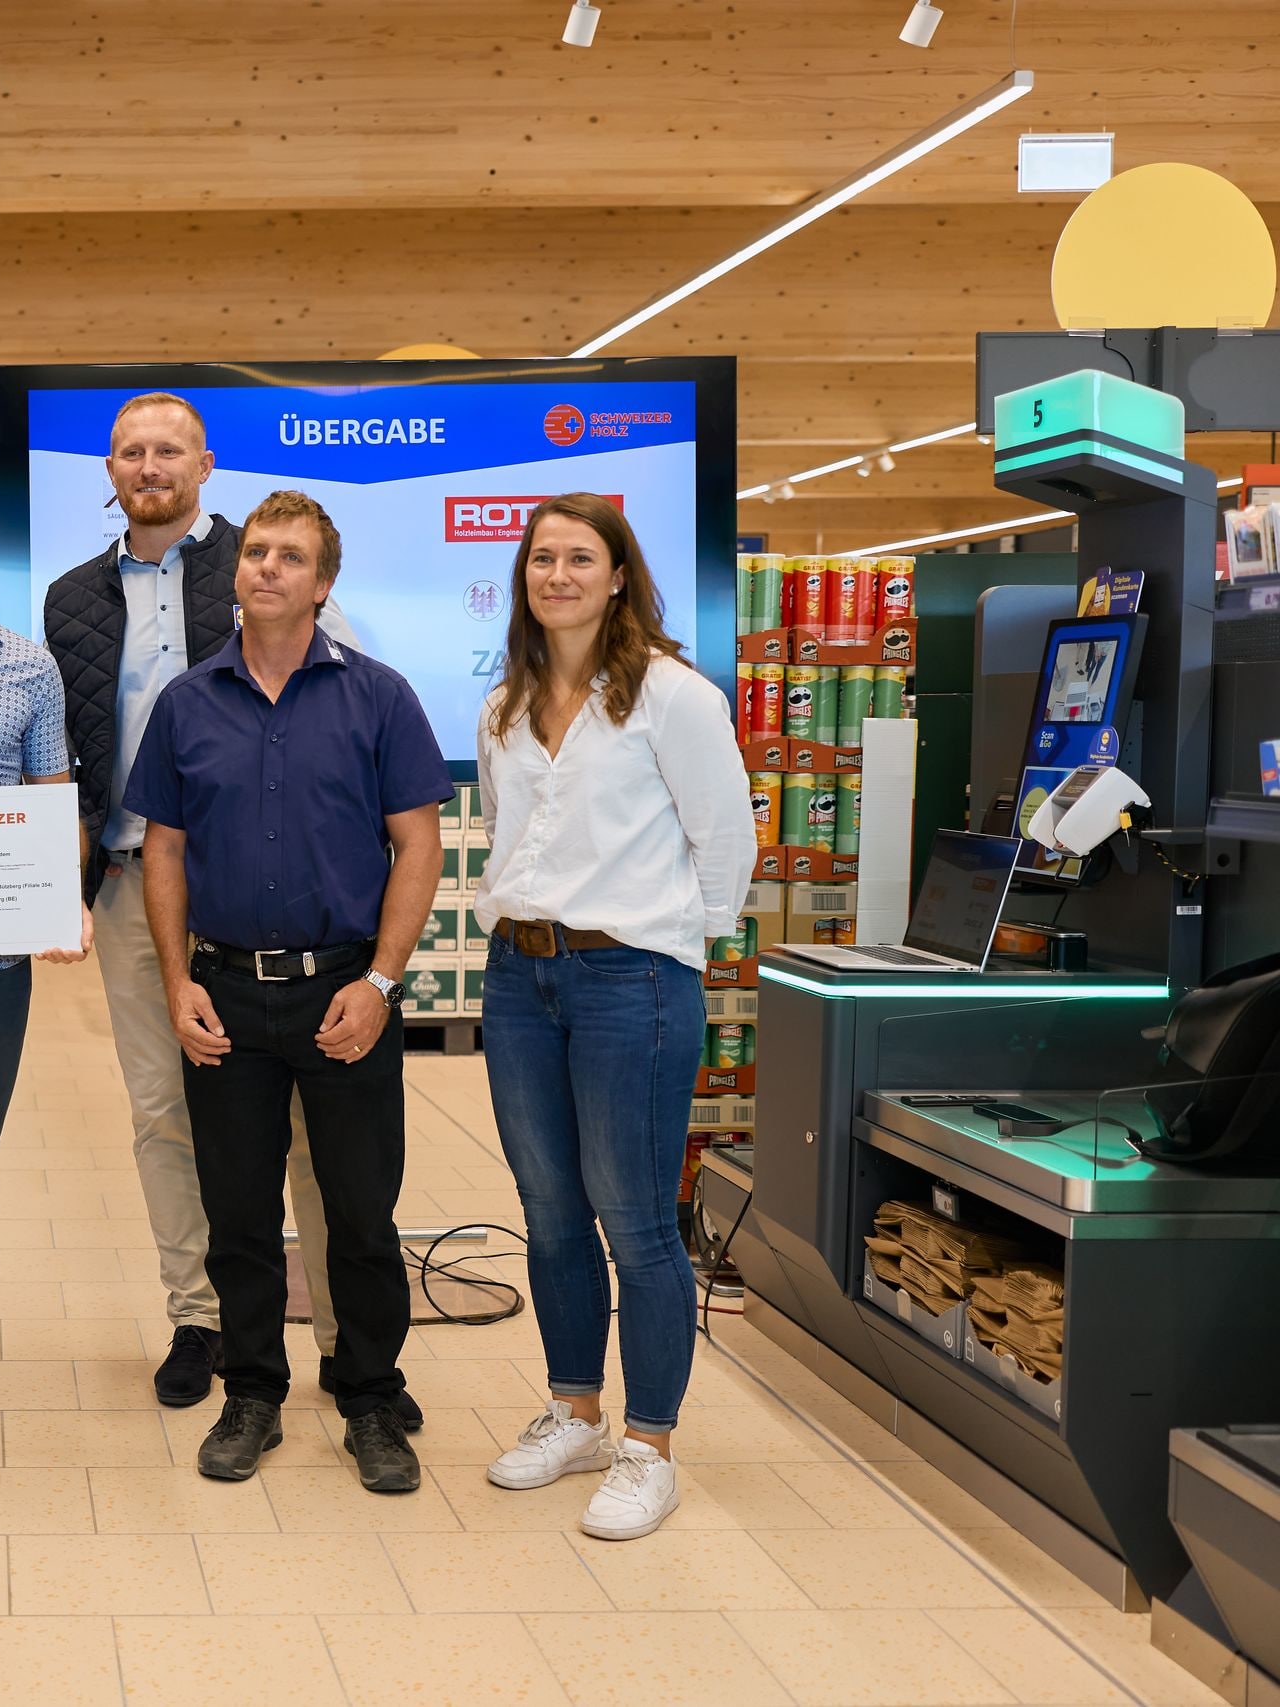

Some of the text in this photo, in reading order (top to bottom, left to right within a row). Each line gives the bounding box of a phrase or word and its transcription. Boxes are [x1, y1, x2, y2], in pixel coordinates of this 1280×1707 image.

[590, 413, 672, 424] SCHWEIZER
[1033, 399, 1043, 428] 5
[279, 413, 446, 446] ÜBERGABE
[590, 426, 629, 437] HOLZ
[884, 596, 909, 608] PRINGLES
[883, 647, 910, 660] PRINGLES
[787, 704, 812, 717] PRINGLES
[1040, 731, 1054, 739] Scan
[710, 967, 738, 980] PRINGLES
[718, 1026, 742, 1038] PRINGLES
[708, 1074, 736, 1087] PRINGLES
